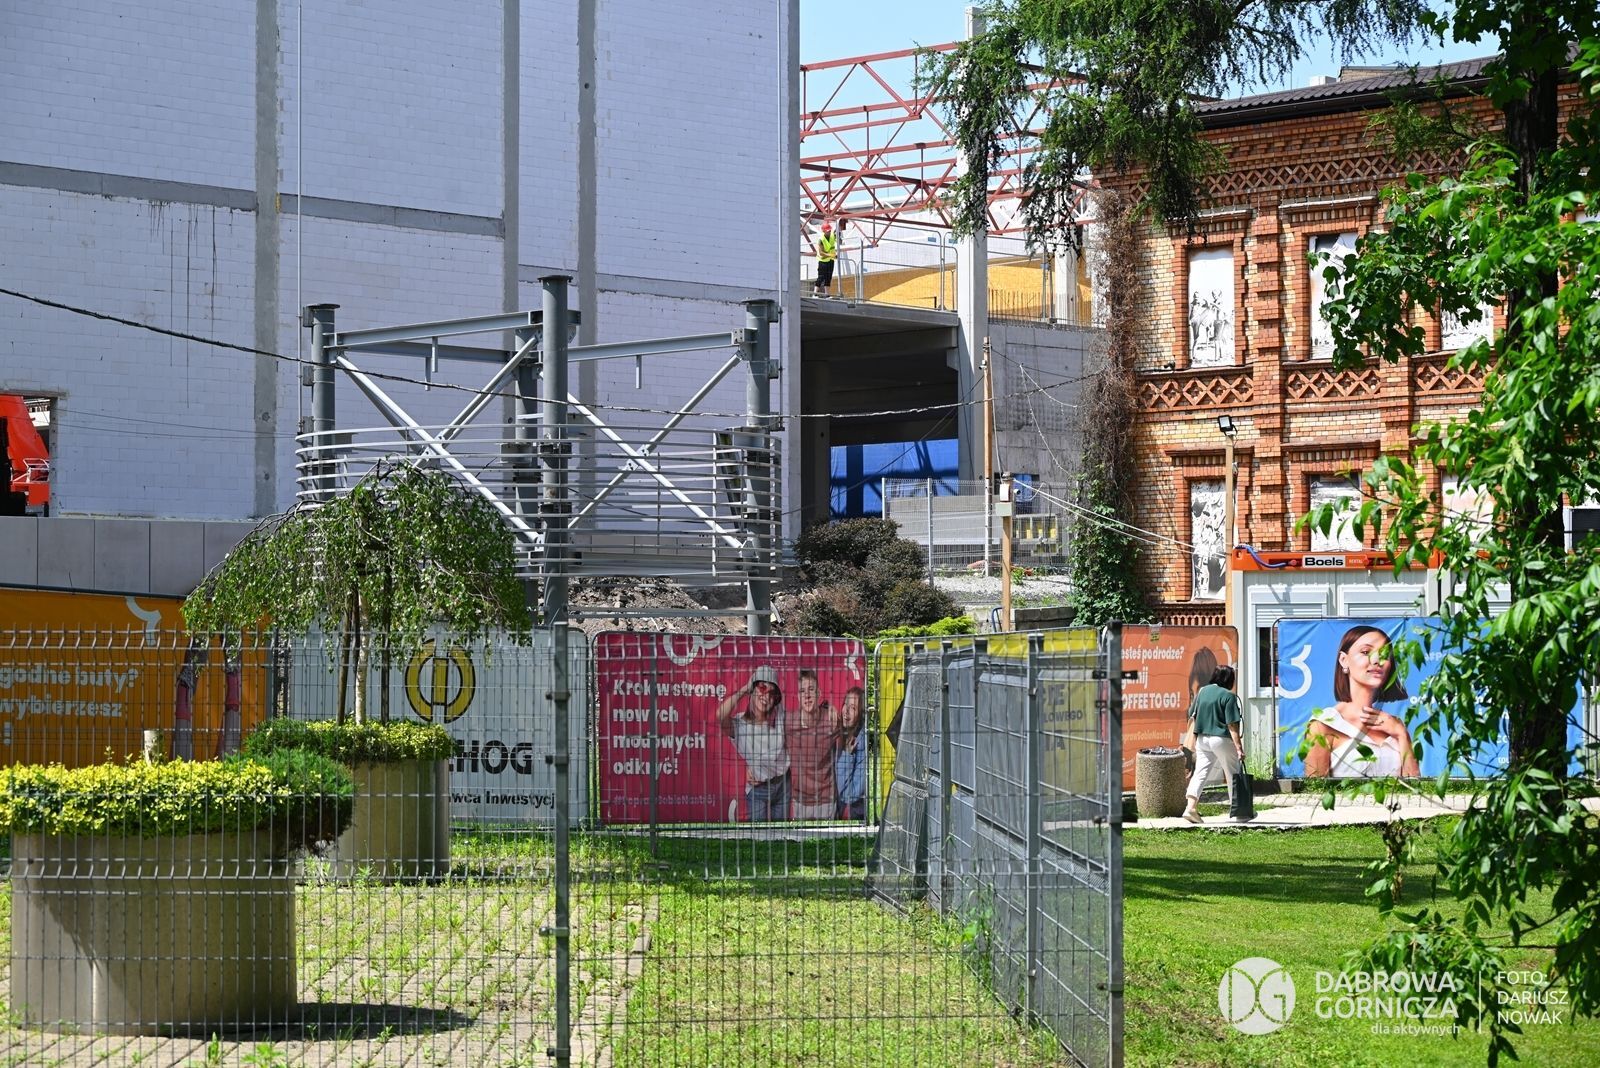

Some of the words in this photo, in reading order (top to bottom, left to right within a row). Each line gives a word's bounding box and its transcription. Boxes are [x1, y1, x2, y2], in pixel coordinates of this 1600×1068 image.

[1304, 557, 1344, 566] Boels
[1121, 644, 1141, 660] esteś
[75, 666, 138, 693] buty?
[613, 679, 651, 696] Krok
[672, 681, 727, 702] stronę
[0, 693, 122, 720] wybierzesz
[1122, 693, 1149, 710] OFFEE
[1149, 692, 1162, 709] TO
[1163, 692, 1181, 709] GO!
[613, 706, 679, 722] nowch
[449, 740, 533, 774] HOG
[448, 792, 481, 804] wca
[485, 790, 555, 809] Inwestycj
